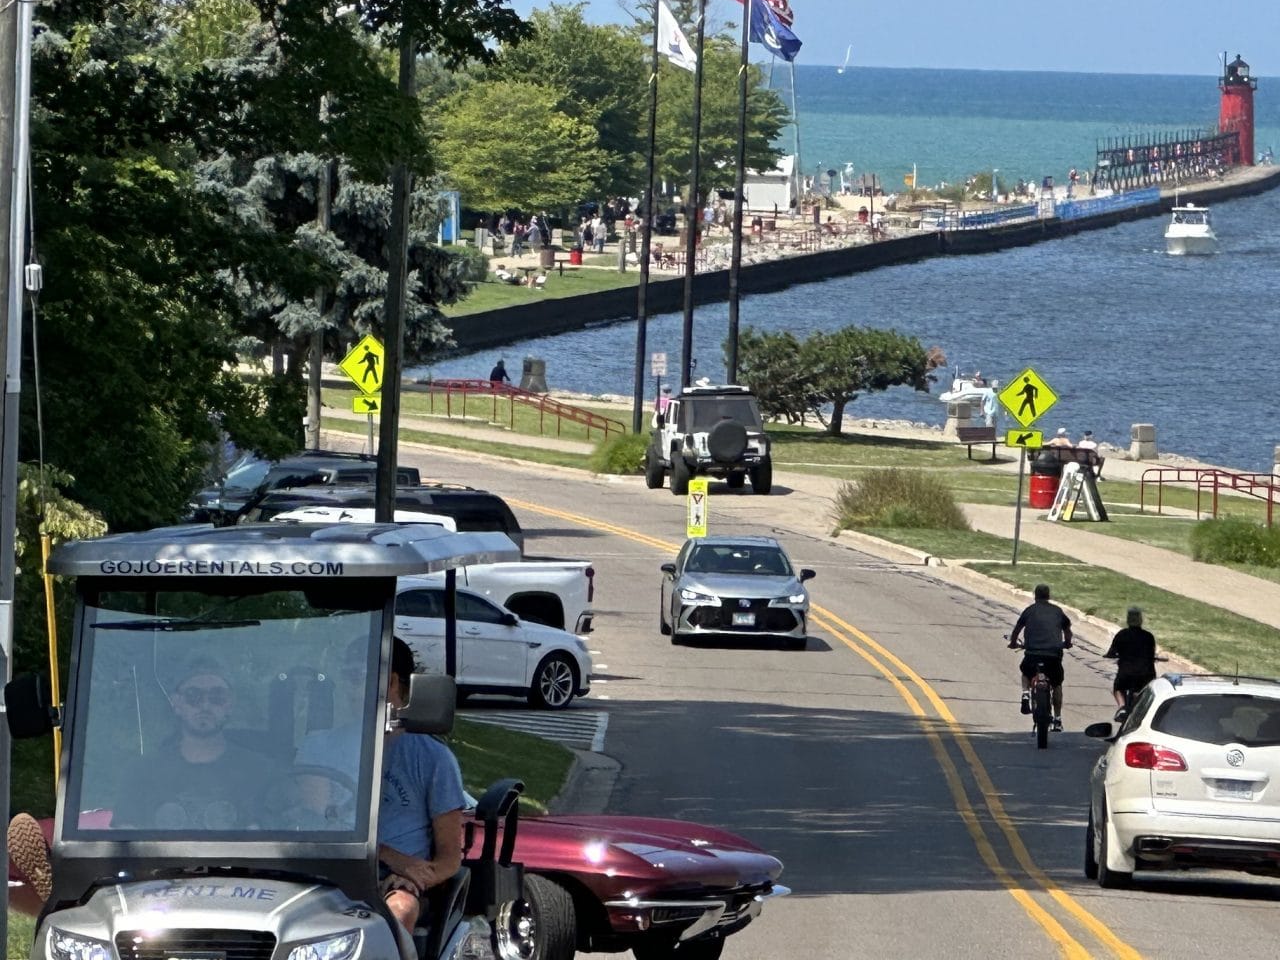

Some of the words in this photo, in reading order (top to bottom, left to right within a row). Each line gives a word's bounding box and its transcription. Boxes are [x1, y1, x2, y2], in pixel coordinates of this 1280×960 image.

[100, 559, 344, 575] GOJOERENTALS.COM
[141, 885, 218, 899] RENT
[231, 887, 277, 901] ME
